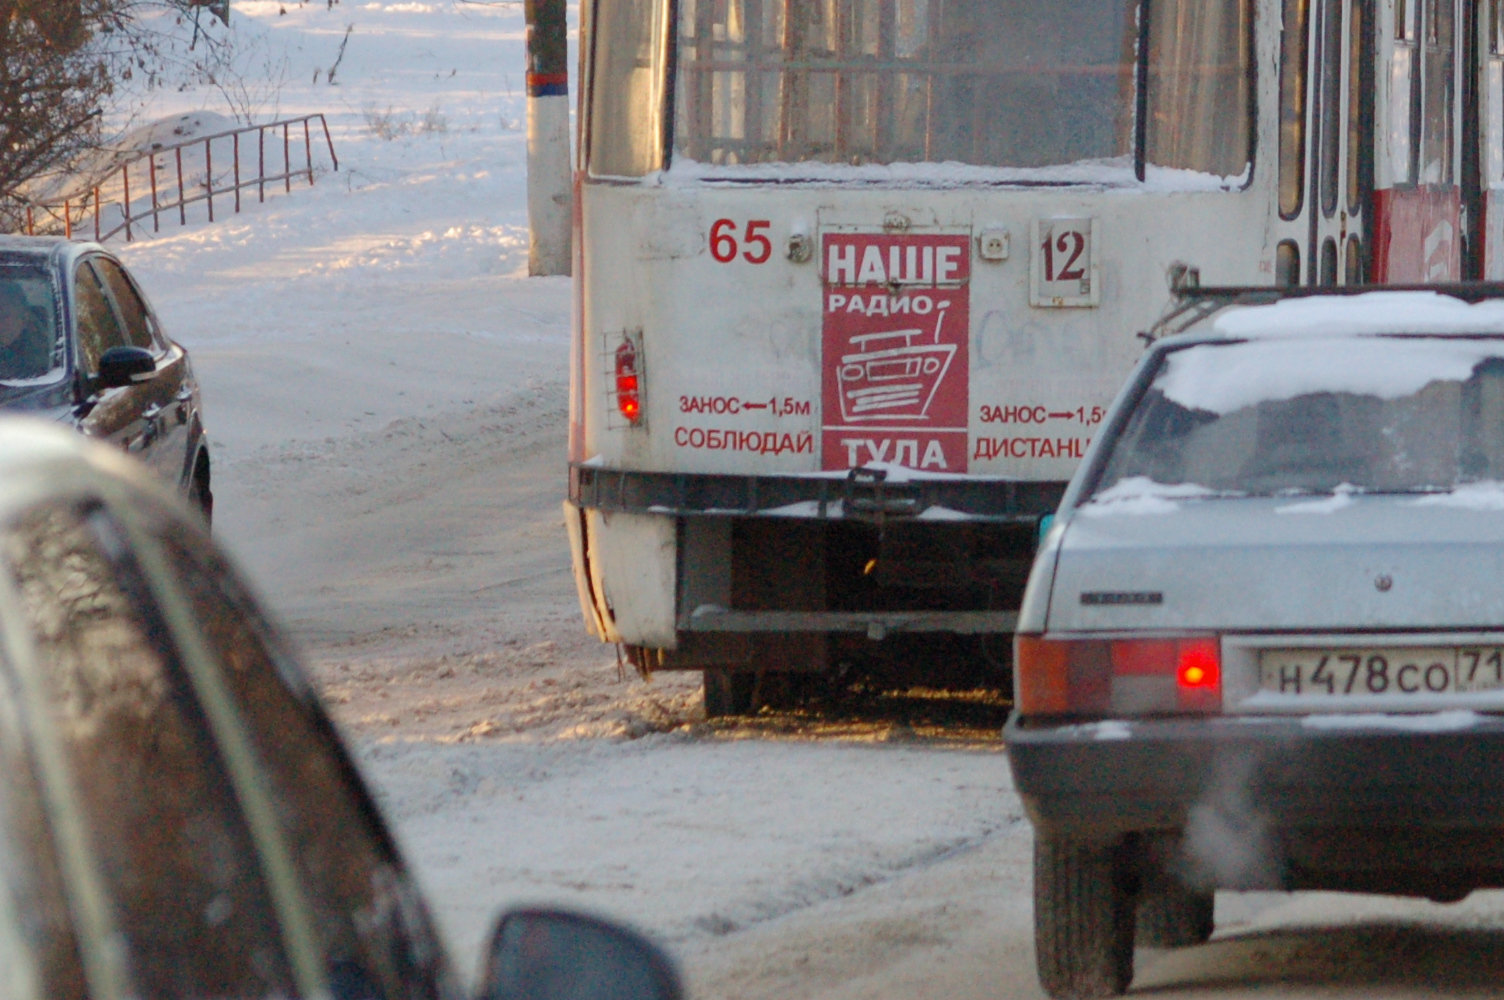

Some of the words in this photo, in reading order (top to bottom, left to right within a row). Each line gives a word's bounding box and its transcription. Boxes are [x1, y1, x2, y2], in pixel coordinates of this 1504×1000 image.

[709, 218, 772, 265] 65
[1041, 229, 1085, 282] 12
[828, 244, 961, 289] НАШЕ
[828, 293, 934, 317] РАДИО
[679, 396, 741, 415] ЗАНОС
[979, 405, 1047, 424] ЗАНОС
[674, 426, 813, 456] СОБЛЮДАЙ
[840, 438, 948, 469] ТУЛА
[1463, 650, 1503, 682] 71
